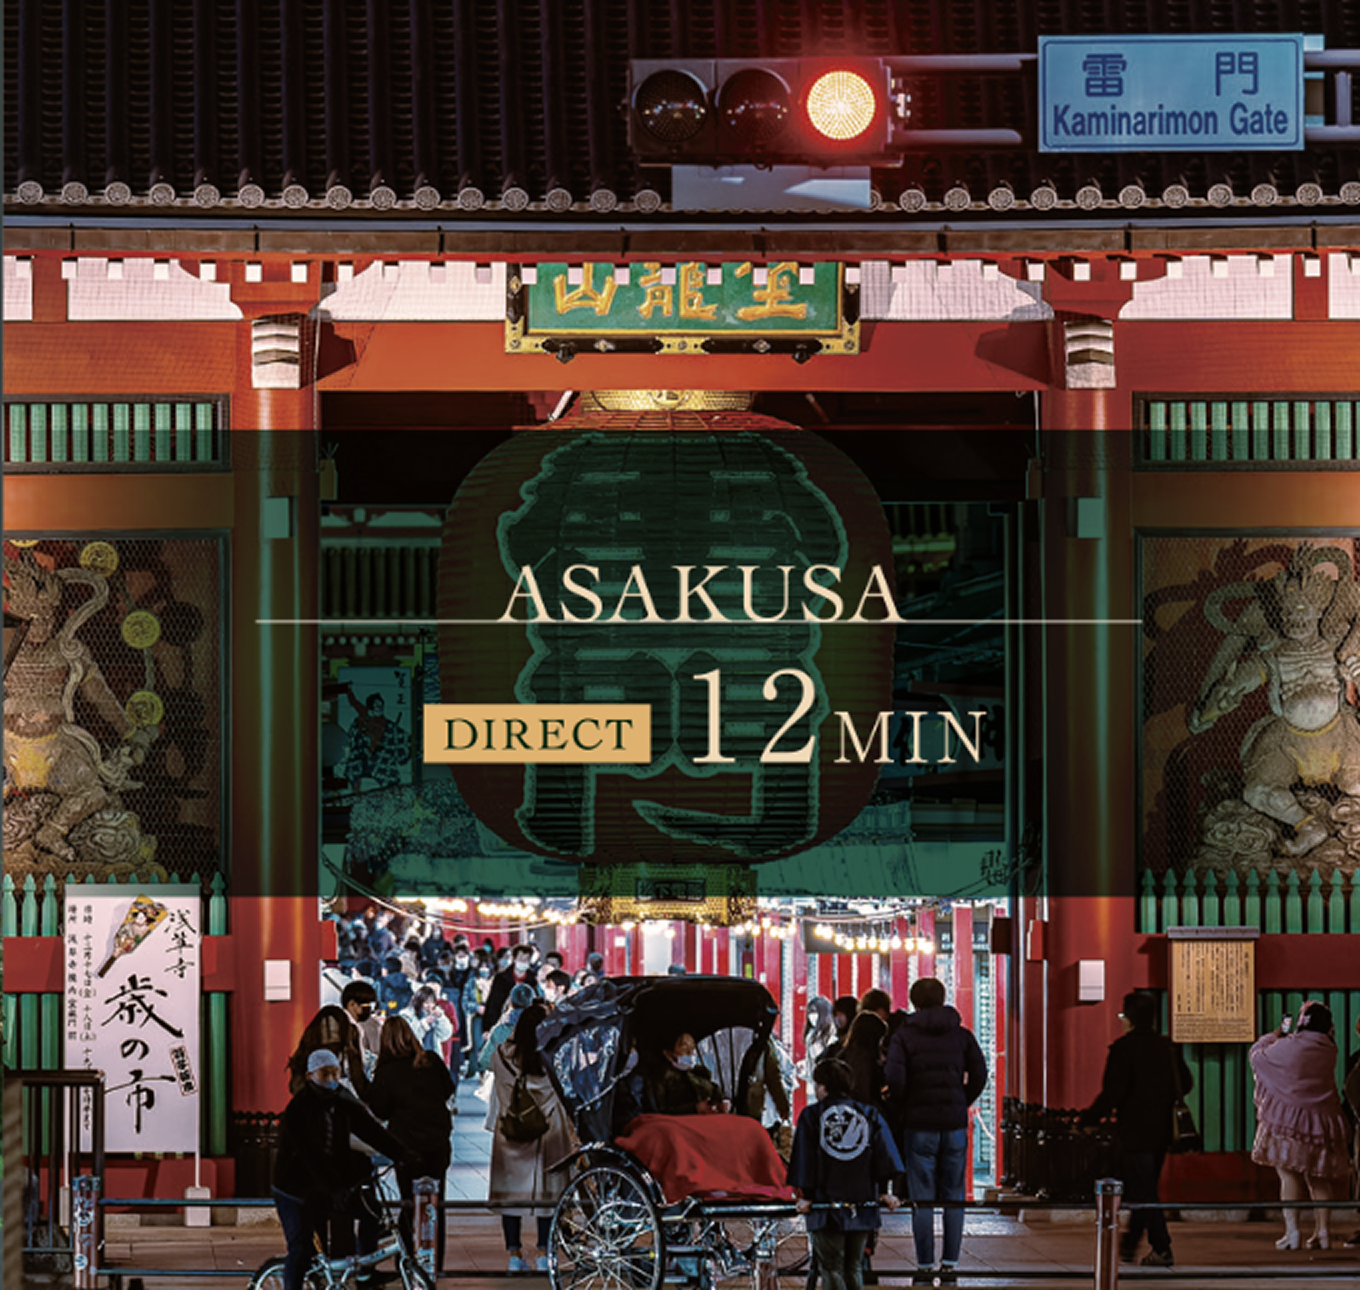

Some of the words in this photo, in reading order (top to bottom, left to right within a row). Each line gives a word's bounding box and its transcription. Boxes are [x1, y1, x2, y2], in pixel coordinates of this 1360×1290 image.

[1053, 104, 1219, 138] Kaminarimon
[1229, 104, 1290, 138] Gate
[102, 974, 184, 1134] 歳の市
